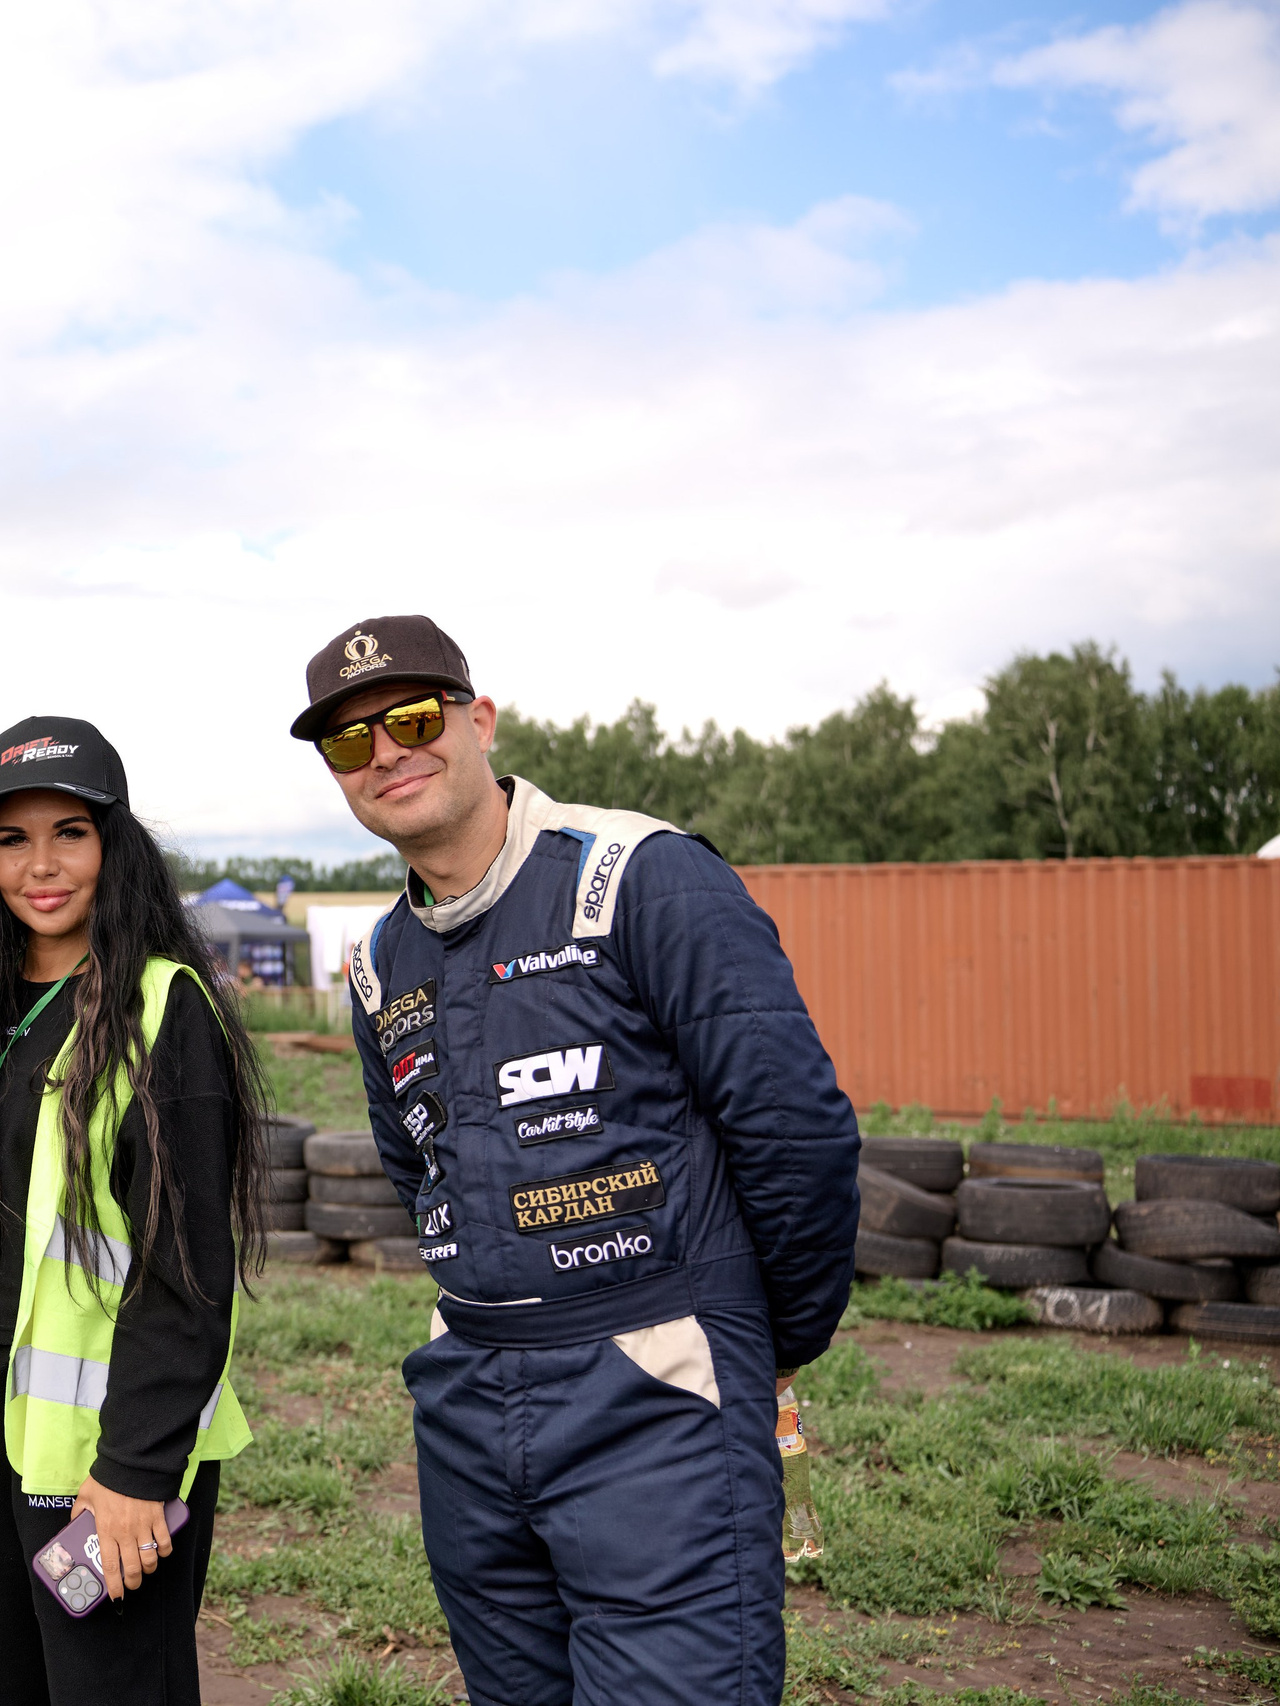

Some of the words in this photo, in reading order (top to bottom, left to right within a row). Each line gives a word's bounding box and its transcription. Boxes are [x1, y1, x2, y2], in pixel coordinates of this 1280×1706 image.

[339, 653, 393, 678] OMEGA
[346, 661, 388, 680] MOTORS
[21, 744, 79, 764] READY
[583, 843, 620, 919] sparco
[498, 1045, 603, 1106] SCW
[513, 1161, 659, 1209] СИБИРСКИЙ
[516, 1195, 615, 1228] КАРДАН
[550, 1232, 652, 1269] bronko
